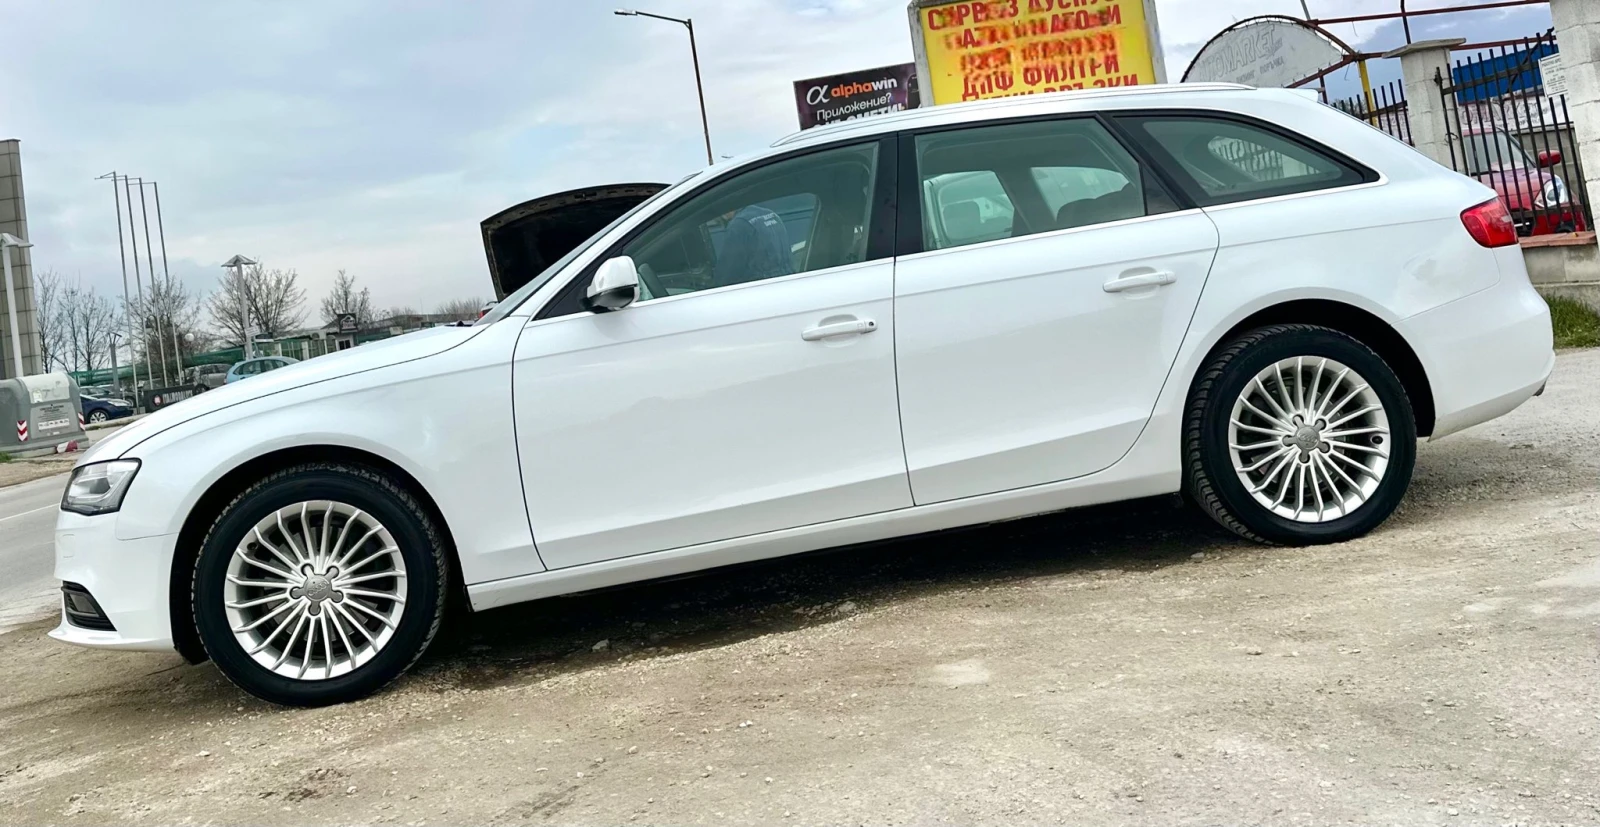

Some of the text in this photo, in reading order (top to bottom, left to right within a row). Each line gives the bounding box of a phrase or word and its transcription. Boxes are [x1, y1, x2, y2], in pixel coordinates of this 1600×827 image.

[927, 0, 1018, 30] СРВЗ
[831, 77, 897, 98] alphawin
[816, 92, 892, 120] Приложение?
